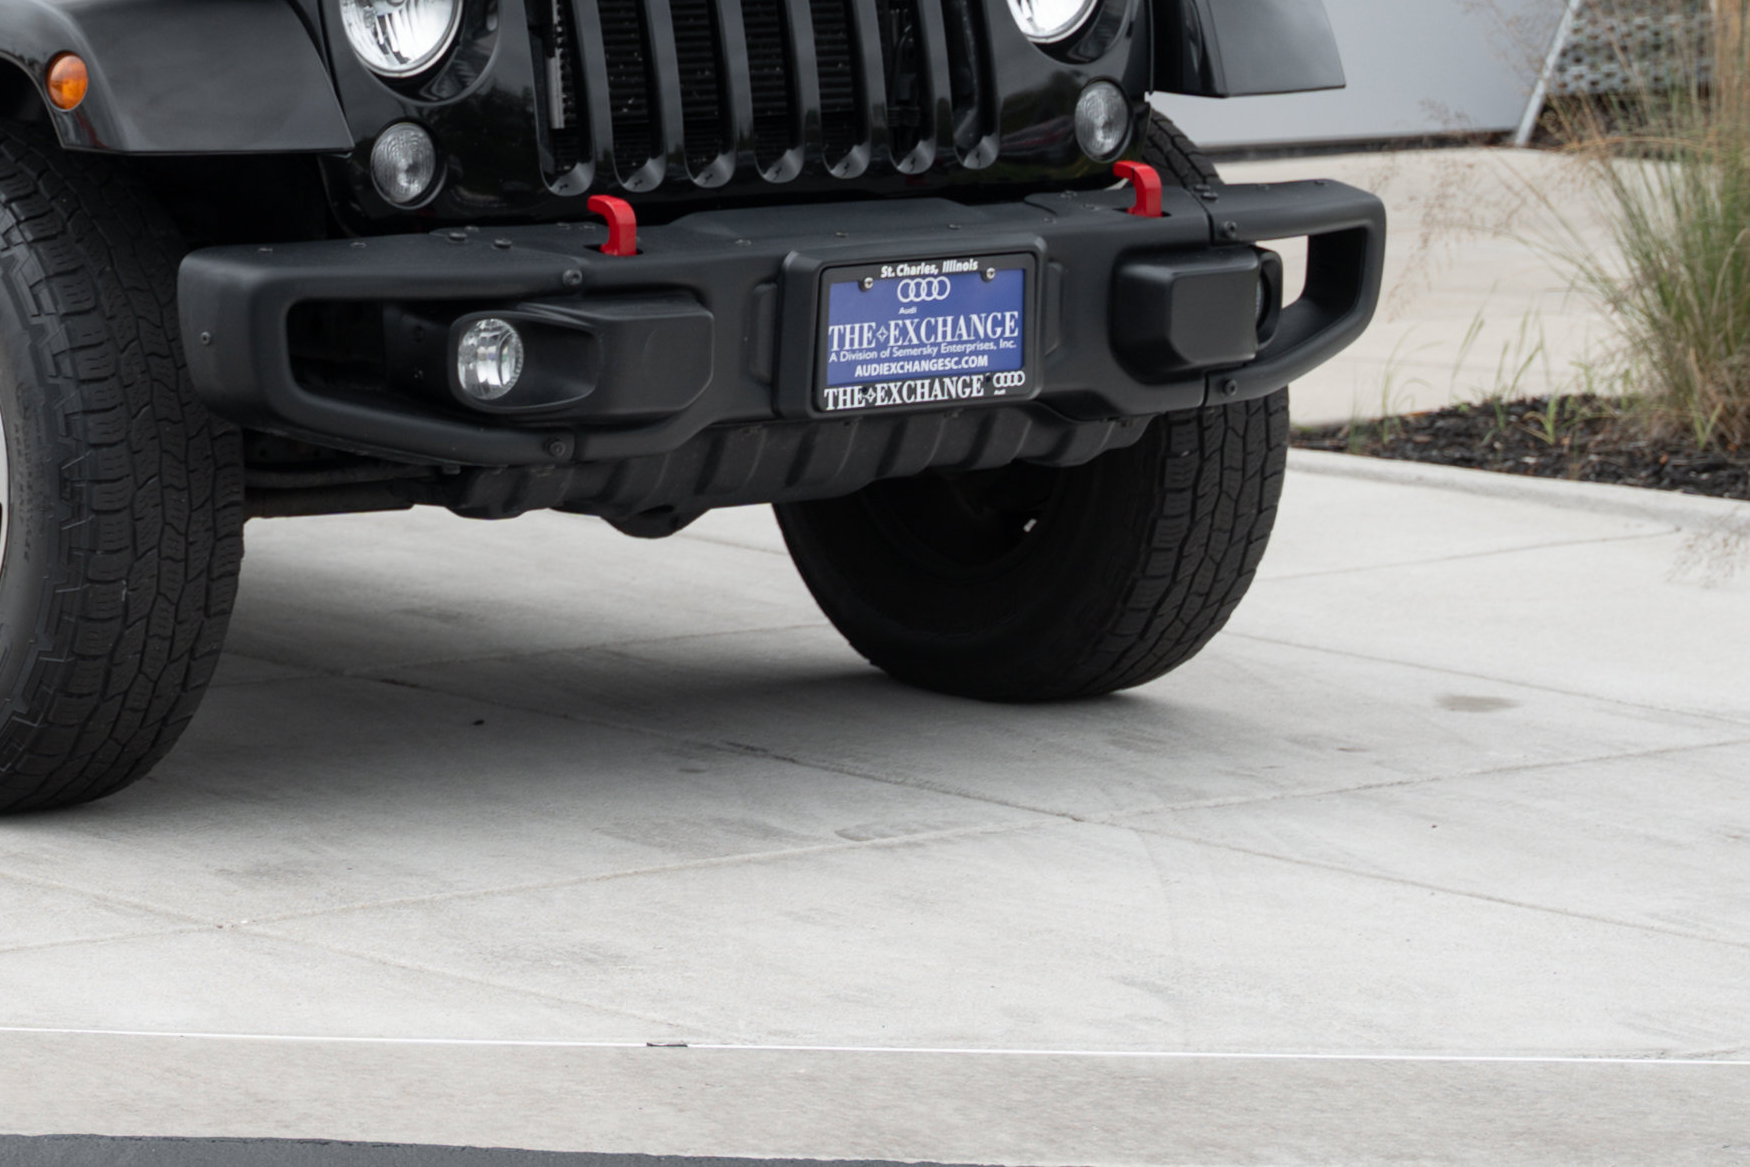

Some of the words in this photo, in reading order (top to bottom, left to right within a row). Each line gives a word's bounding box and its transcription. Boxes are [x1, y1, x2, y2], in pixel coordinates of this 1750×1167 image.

[880, 265, 895, 278] St.
[896, 262, 939, 276] Charles,
[941, 258, 979, 273] Illinois
[898, 306, 917, 315] Audi
[828, 322, 876, 351] THE
[888, 311, 1019, 347] EXCHANGE
[828, 352, 838, 362] A
[840, 350, 878, 362] Division
[880, 347, 891, 358] of
[892, 344, 939, 357] Semersky
[941, 340, 997, 354] Enterprises,
[999, 338, 1017, 349] Inc.
[854, 355, 989, 377] AUDIEXCHANGESC.COM
[824, 385, 866, 411] THE
[874, 375, 985, 407] EXCHANGE
